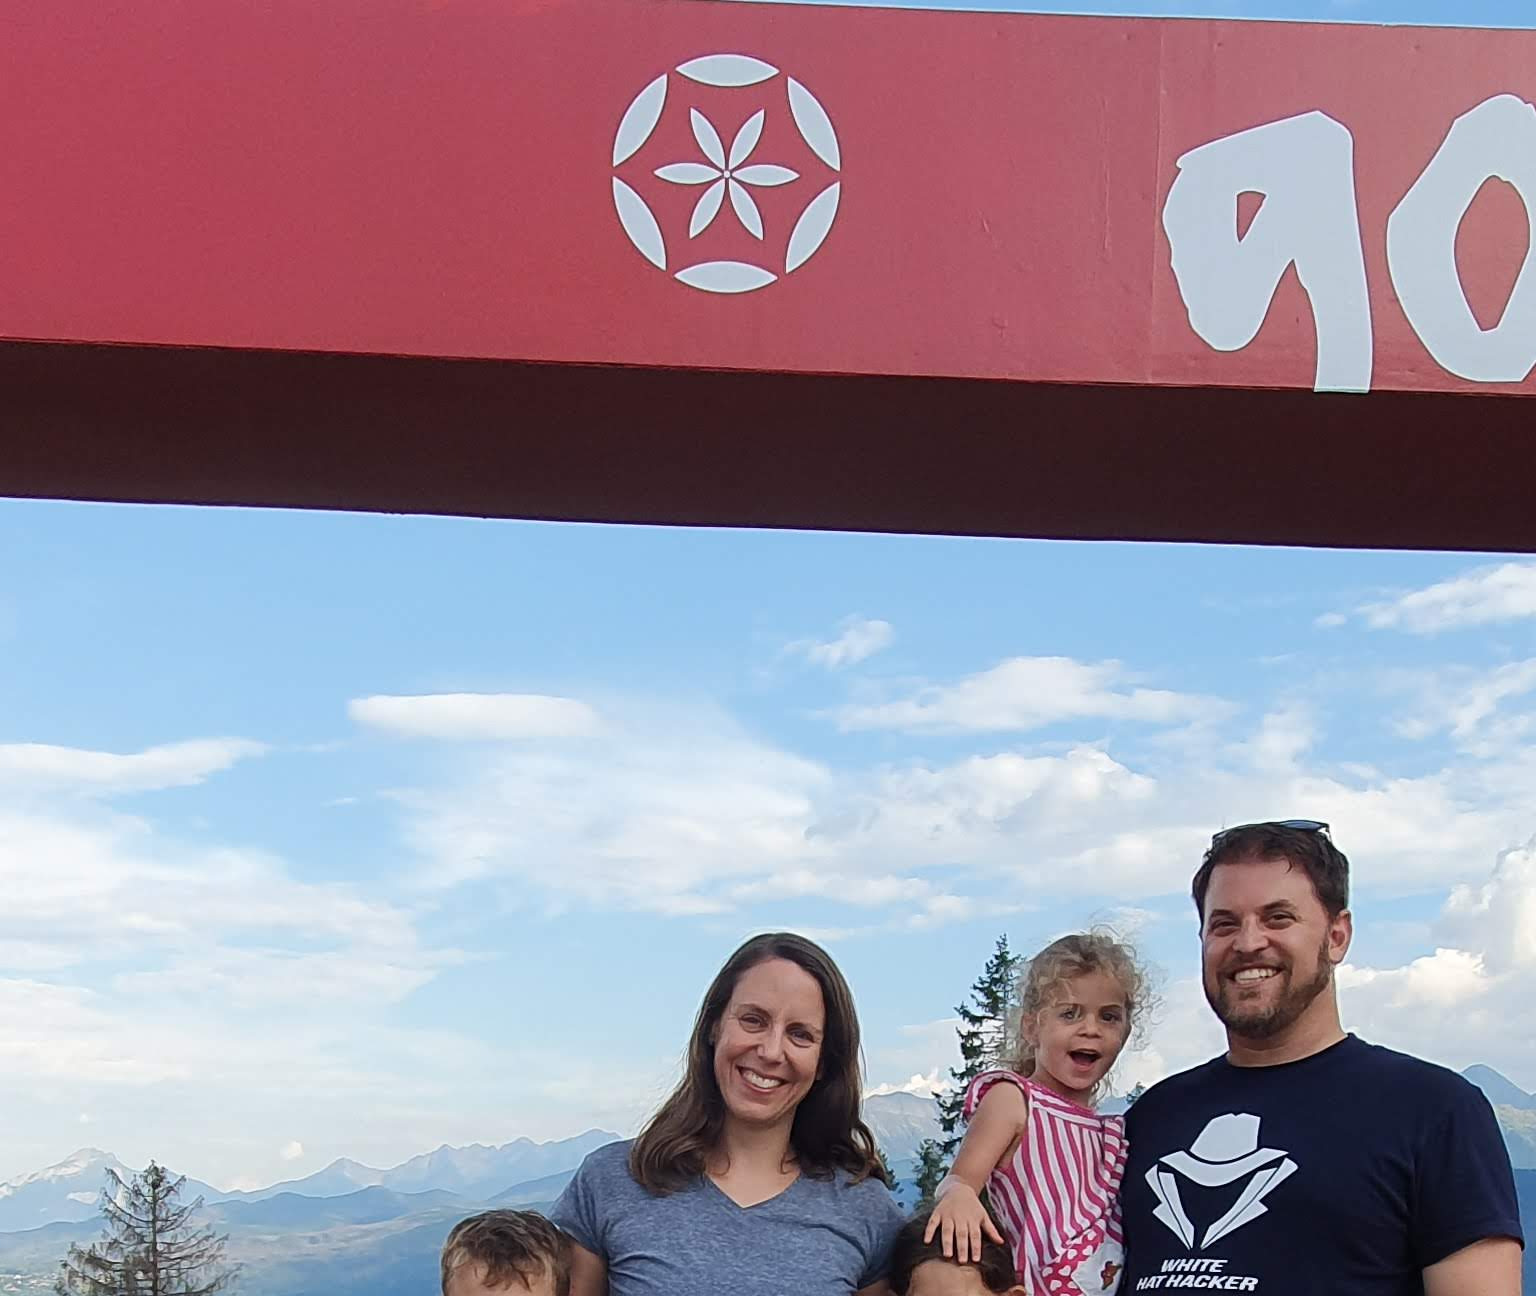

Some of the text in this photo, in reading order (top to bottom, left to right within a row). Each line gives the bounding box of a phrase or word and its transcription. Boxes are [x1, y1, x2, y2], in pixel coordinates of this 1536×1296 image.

[1161, 1259, 1228, 1272] WHITE
[1136, 1275, 1259, 1291] HAT HACKER
